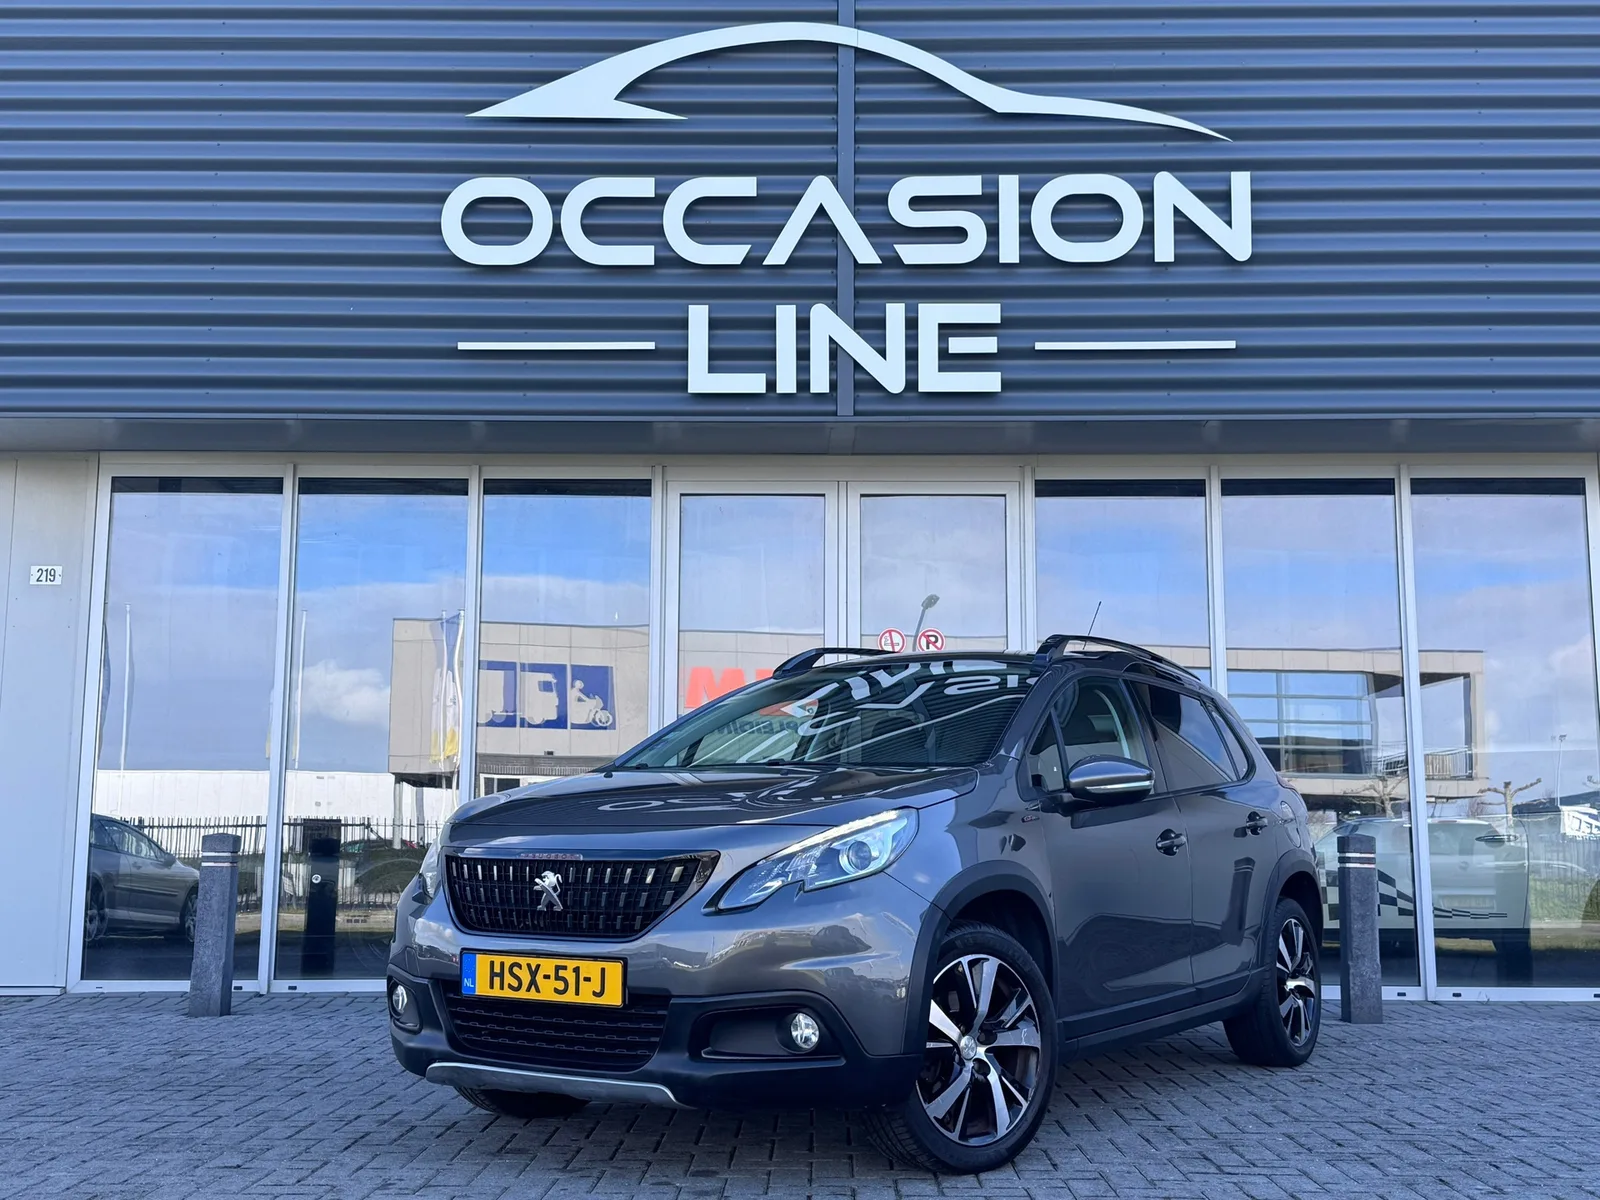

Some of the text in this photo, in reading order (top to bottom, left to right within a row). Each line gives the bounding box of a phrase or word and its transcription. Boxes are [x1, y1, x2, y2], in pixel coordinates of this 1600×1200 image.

[440, 170, 1253, 266] OCCASION
[687, 302, 1002, 395] LINE
[36, 567, 56, 583] 219
[463, 977, 475, 988] NL
[489, 960, 606, 998] HSX-51-J
